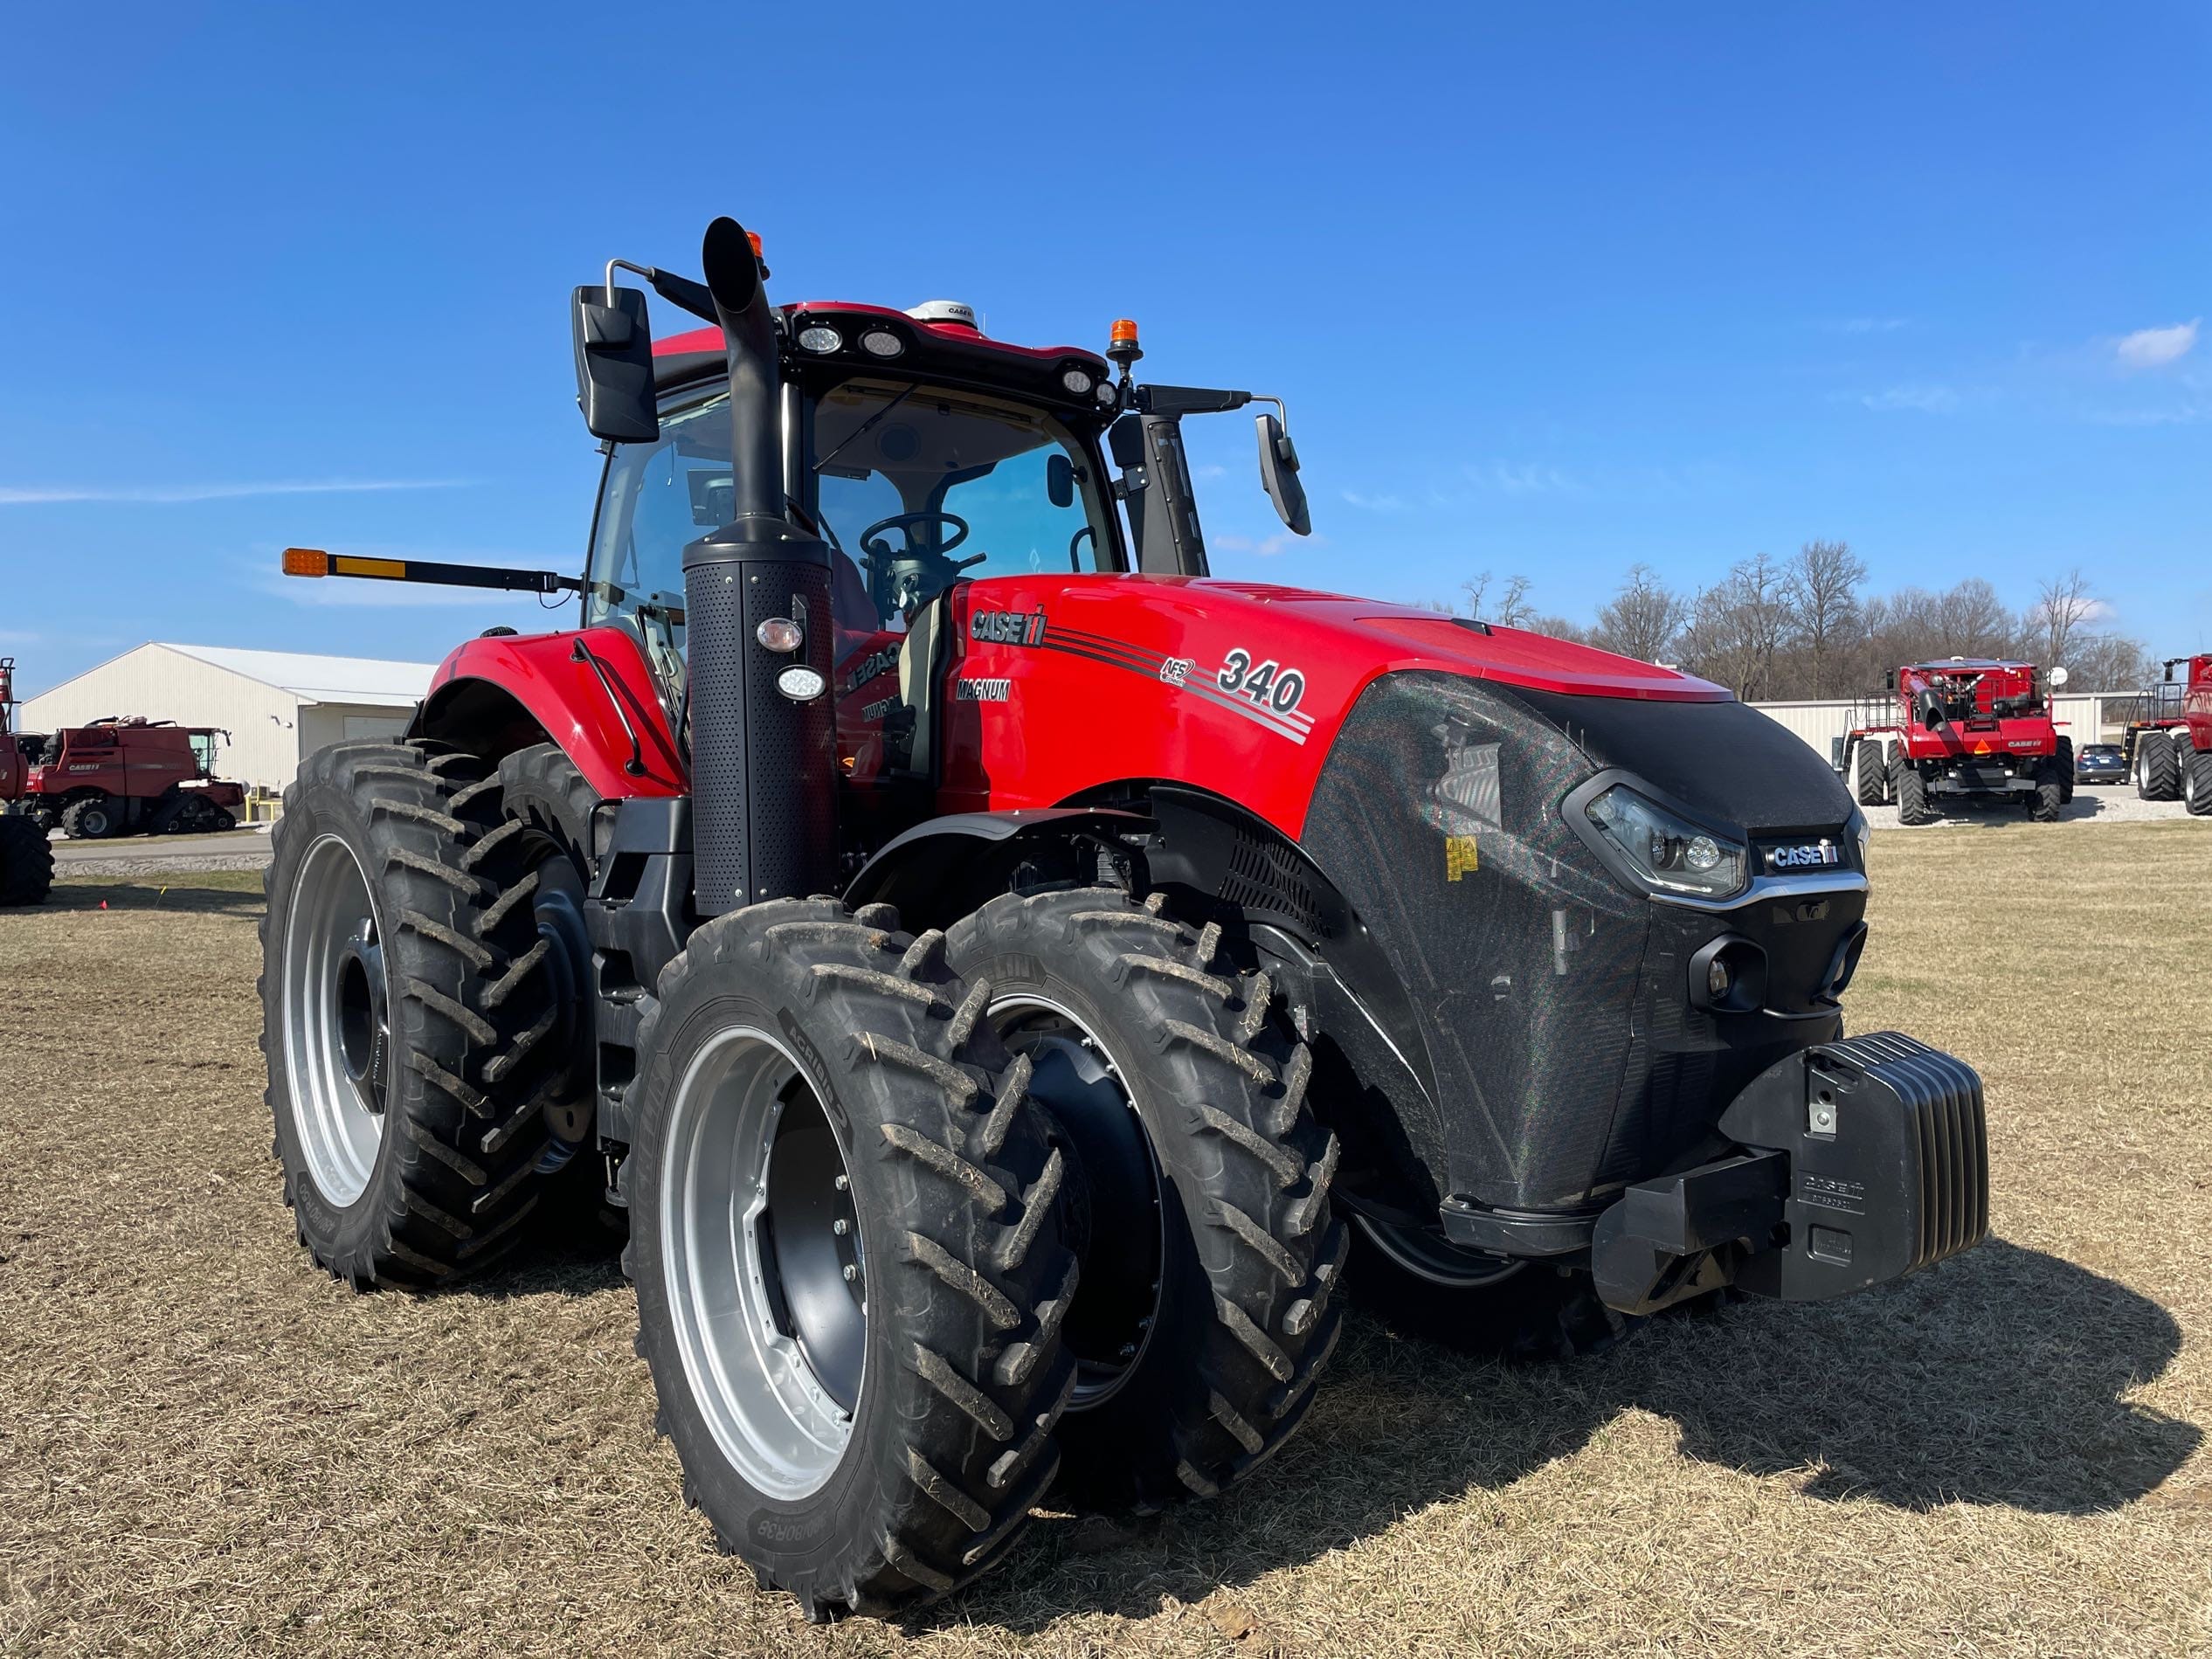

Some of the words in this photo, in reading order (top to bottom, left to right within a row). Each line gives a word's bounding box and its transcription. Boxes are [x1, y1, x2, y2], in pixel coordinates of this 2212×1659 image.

[971, 609, 1025, 644] CASE
[1161, 658, 1188, 678] AFS
[957, 678, 1011, 702] MAGNUM
[1218, 647, 1305, 716] 340
[1774, 846, 1822, 867] CASE
